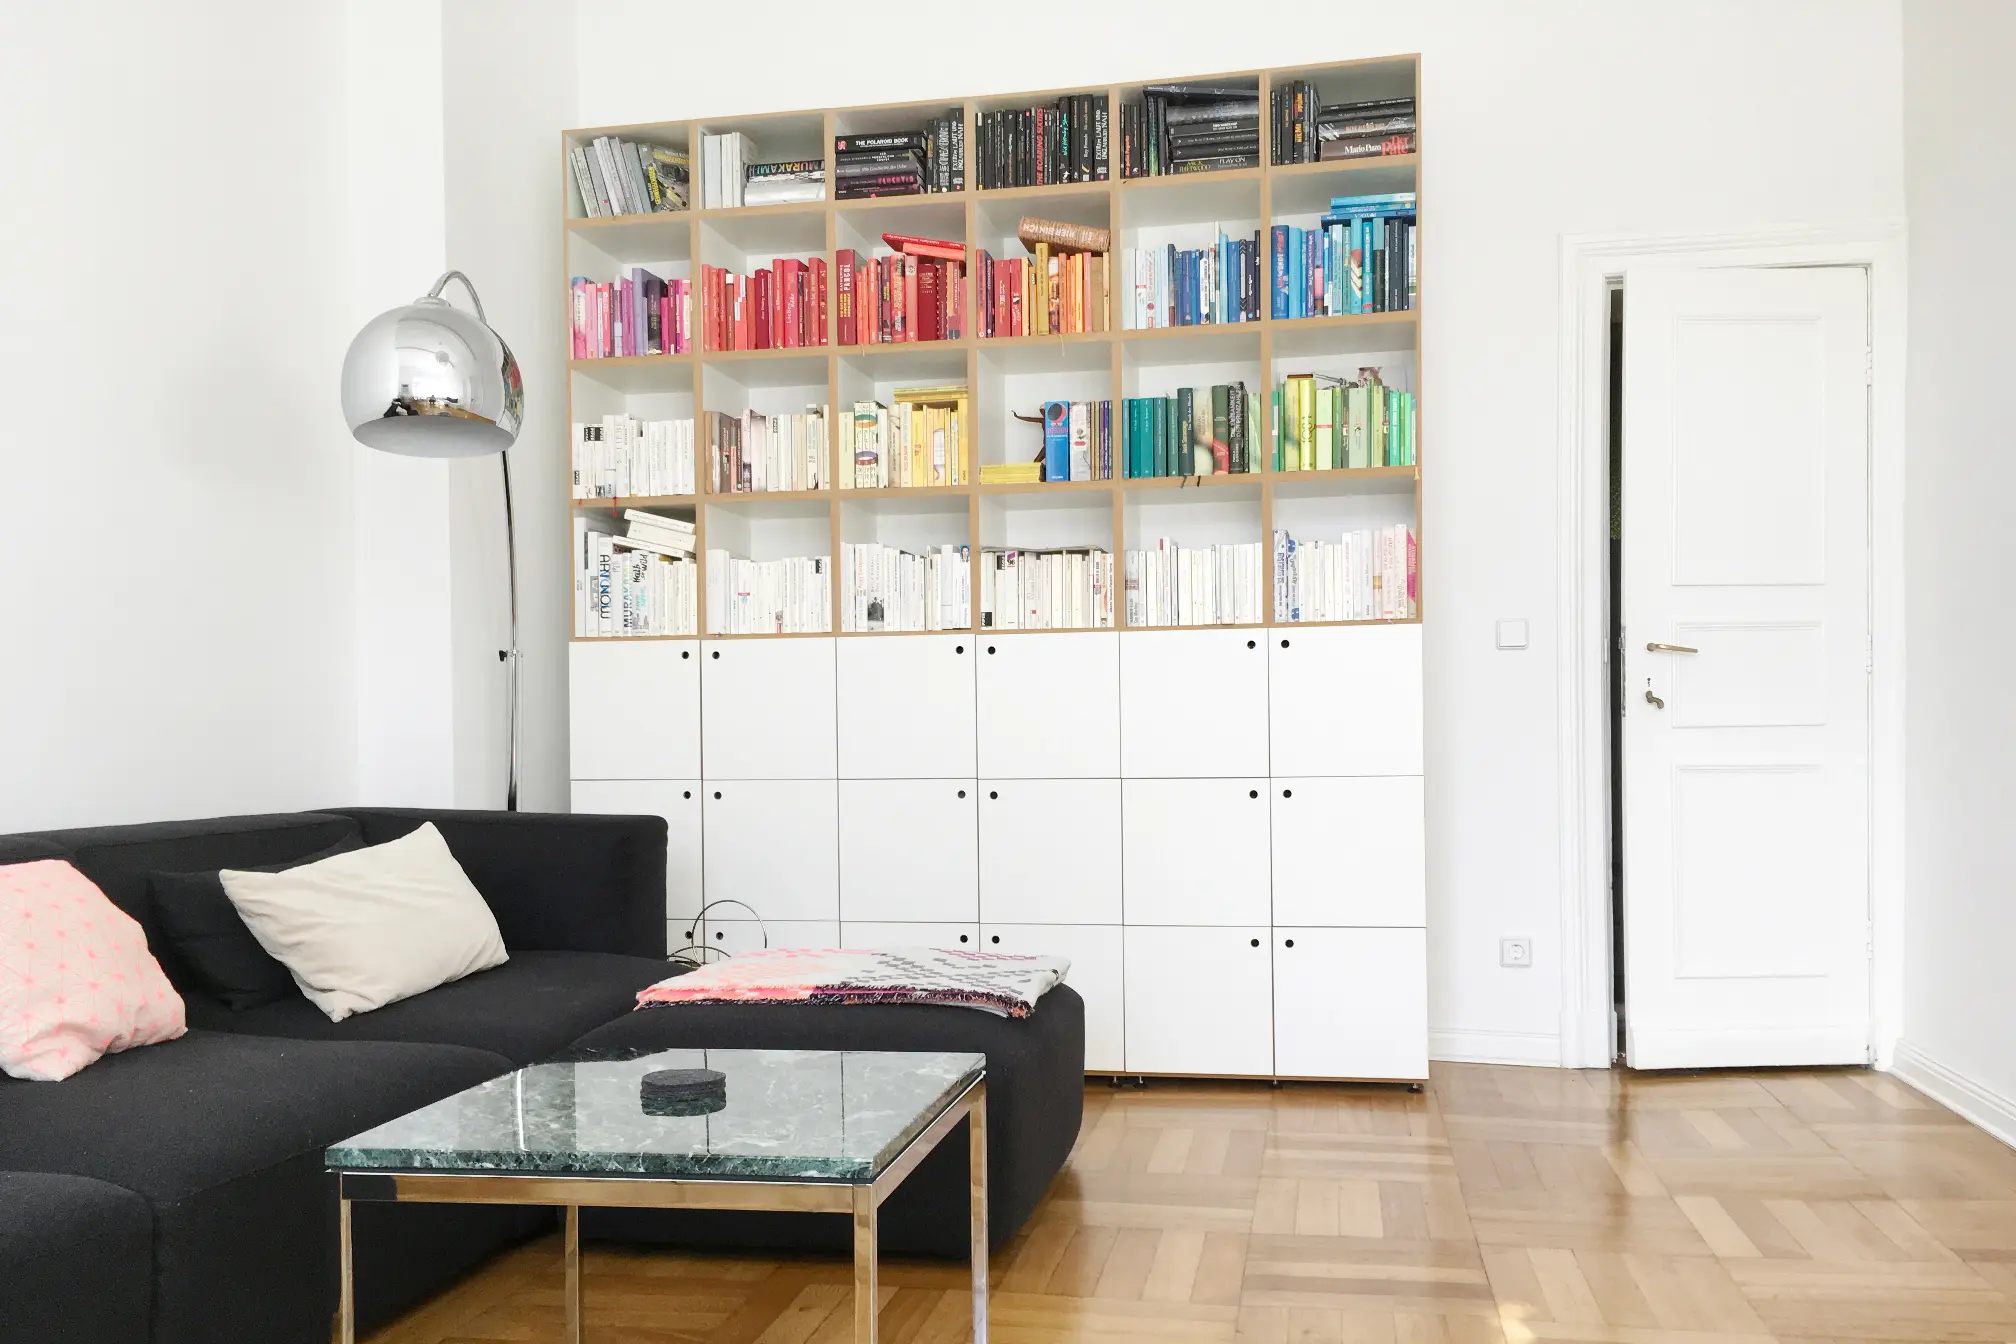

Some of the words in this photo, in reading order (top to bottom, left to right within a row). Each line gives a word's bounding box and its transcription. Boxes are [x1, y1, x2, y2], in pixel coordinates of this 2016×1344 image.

[1345, 145, 1365, 154] Mario
[757, 161, 820, 174] MURAKAMI
[1022, 222, 1039, 233] ICH
[632, 564, 641, 583] Halb
